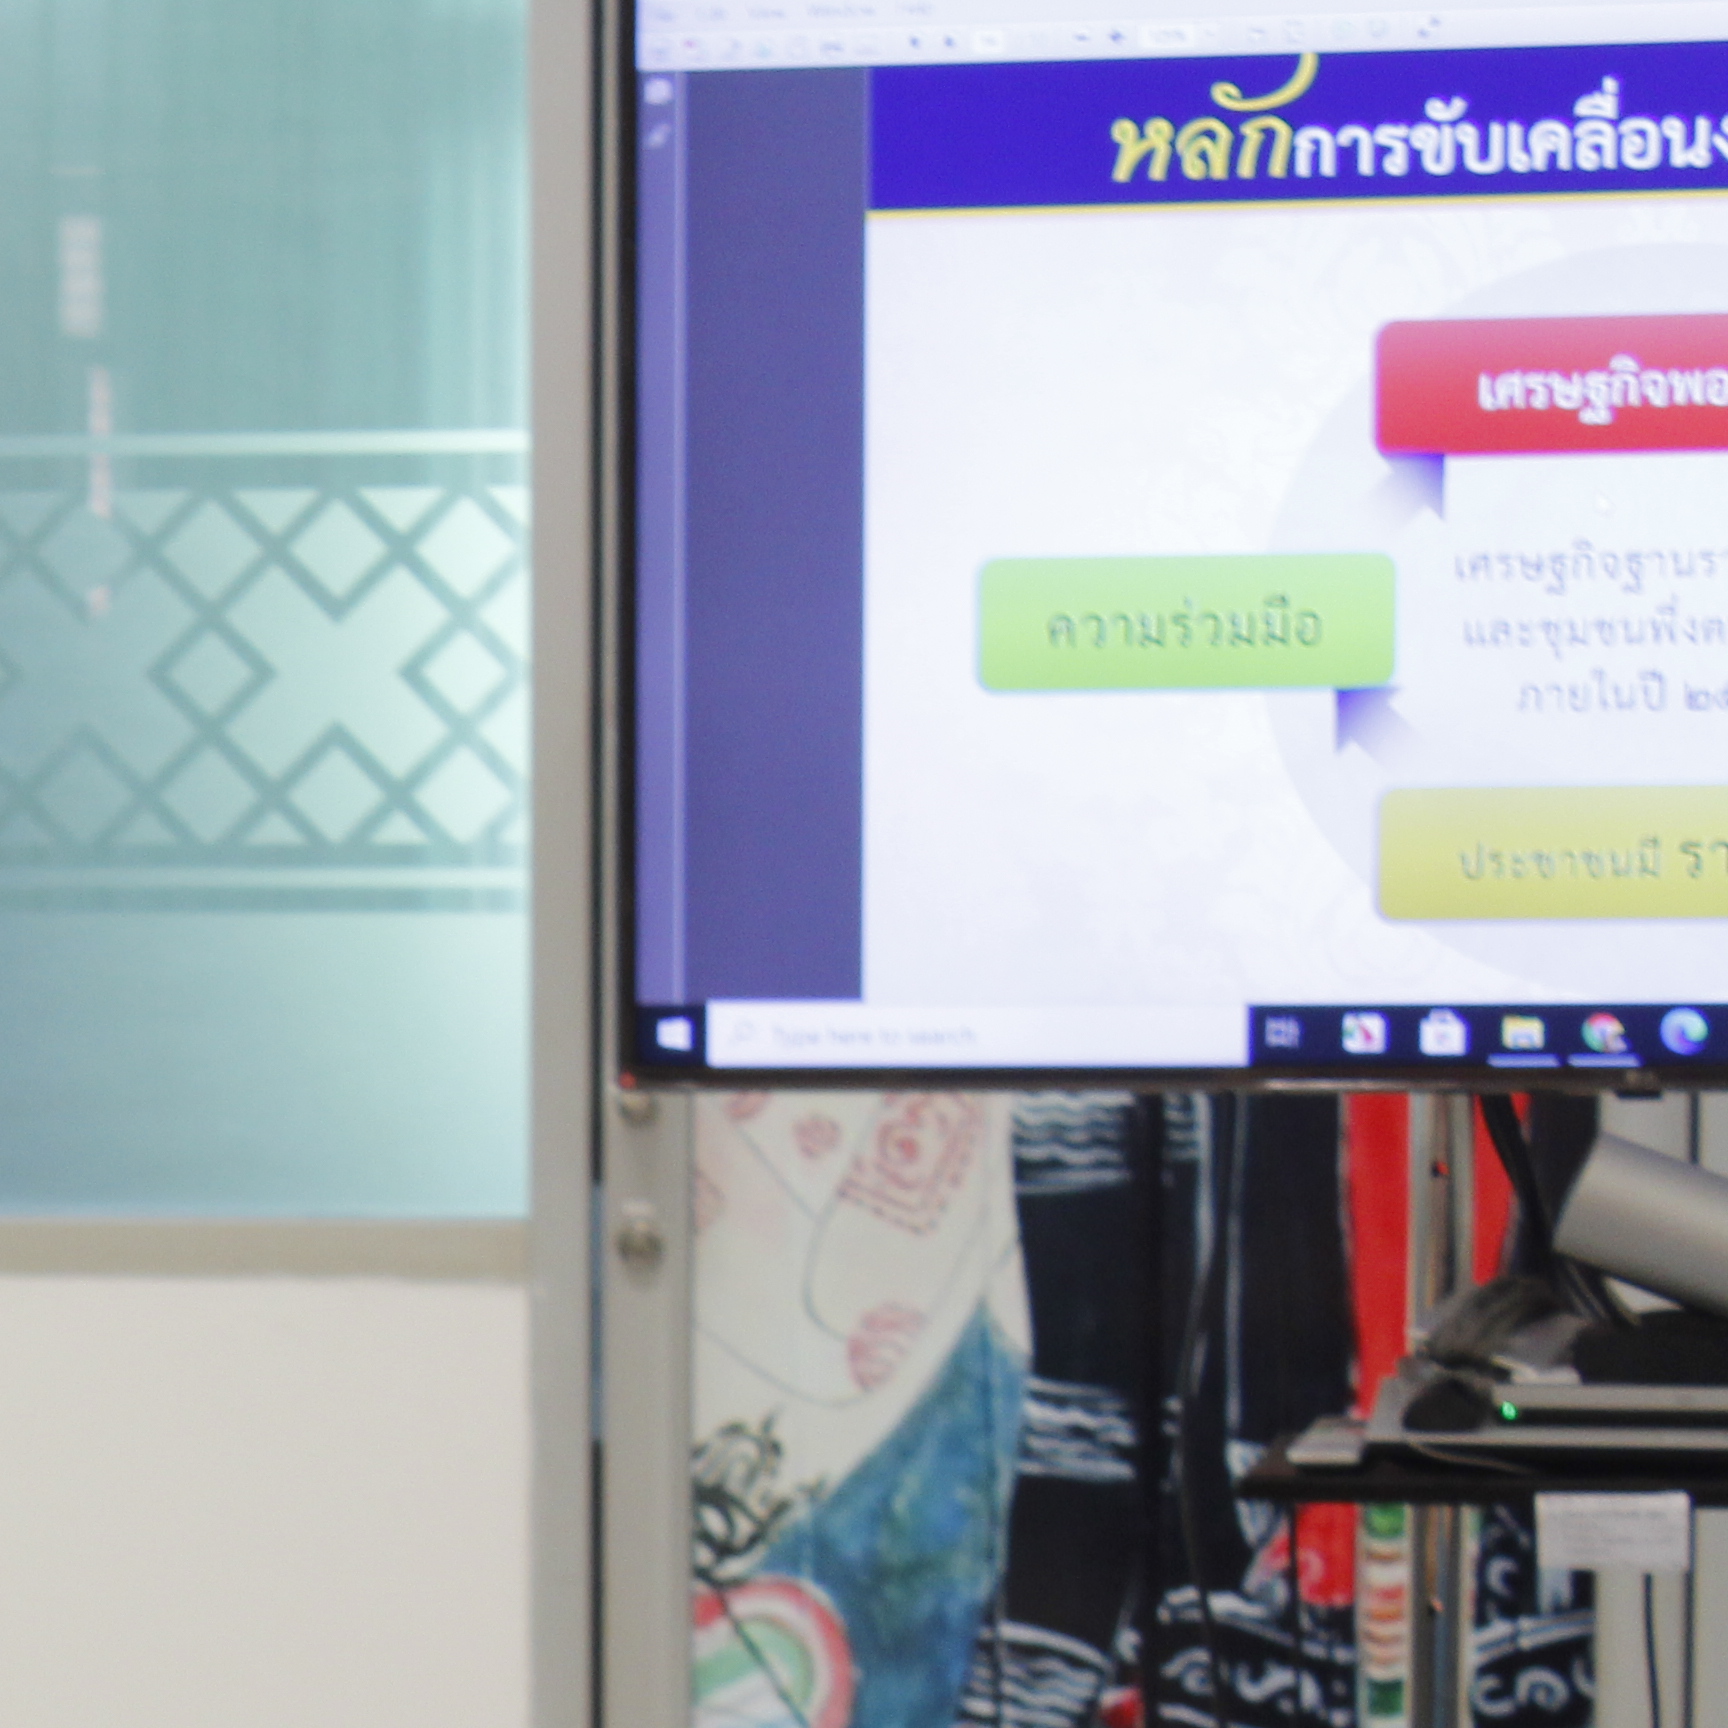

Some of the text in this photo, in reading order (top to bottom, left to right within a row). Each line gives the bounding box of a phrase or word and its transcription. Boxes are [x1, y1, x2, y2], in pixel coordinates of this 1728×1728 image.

[1047, 592, 1324, 649] ความร่วมมือ
[1516, 667, 1666, 713] ภายในปี
[1458, 834, 1662, 881] ประชาชนมี
